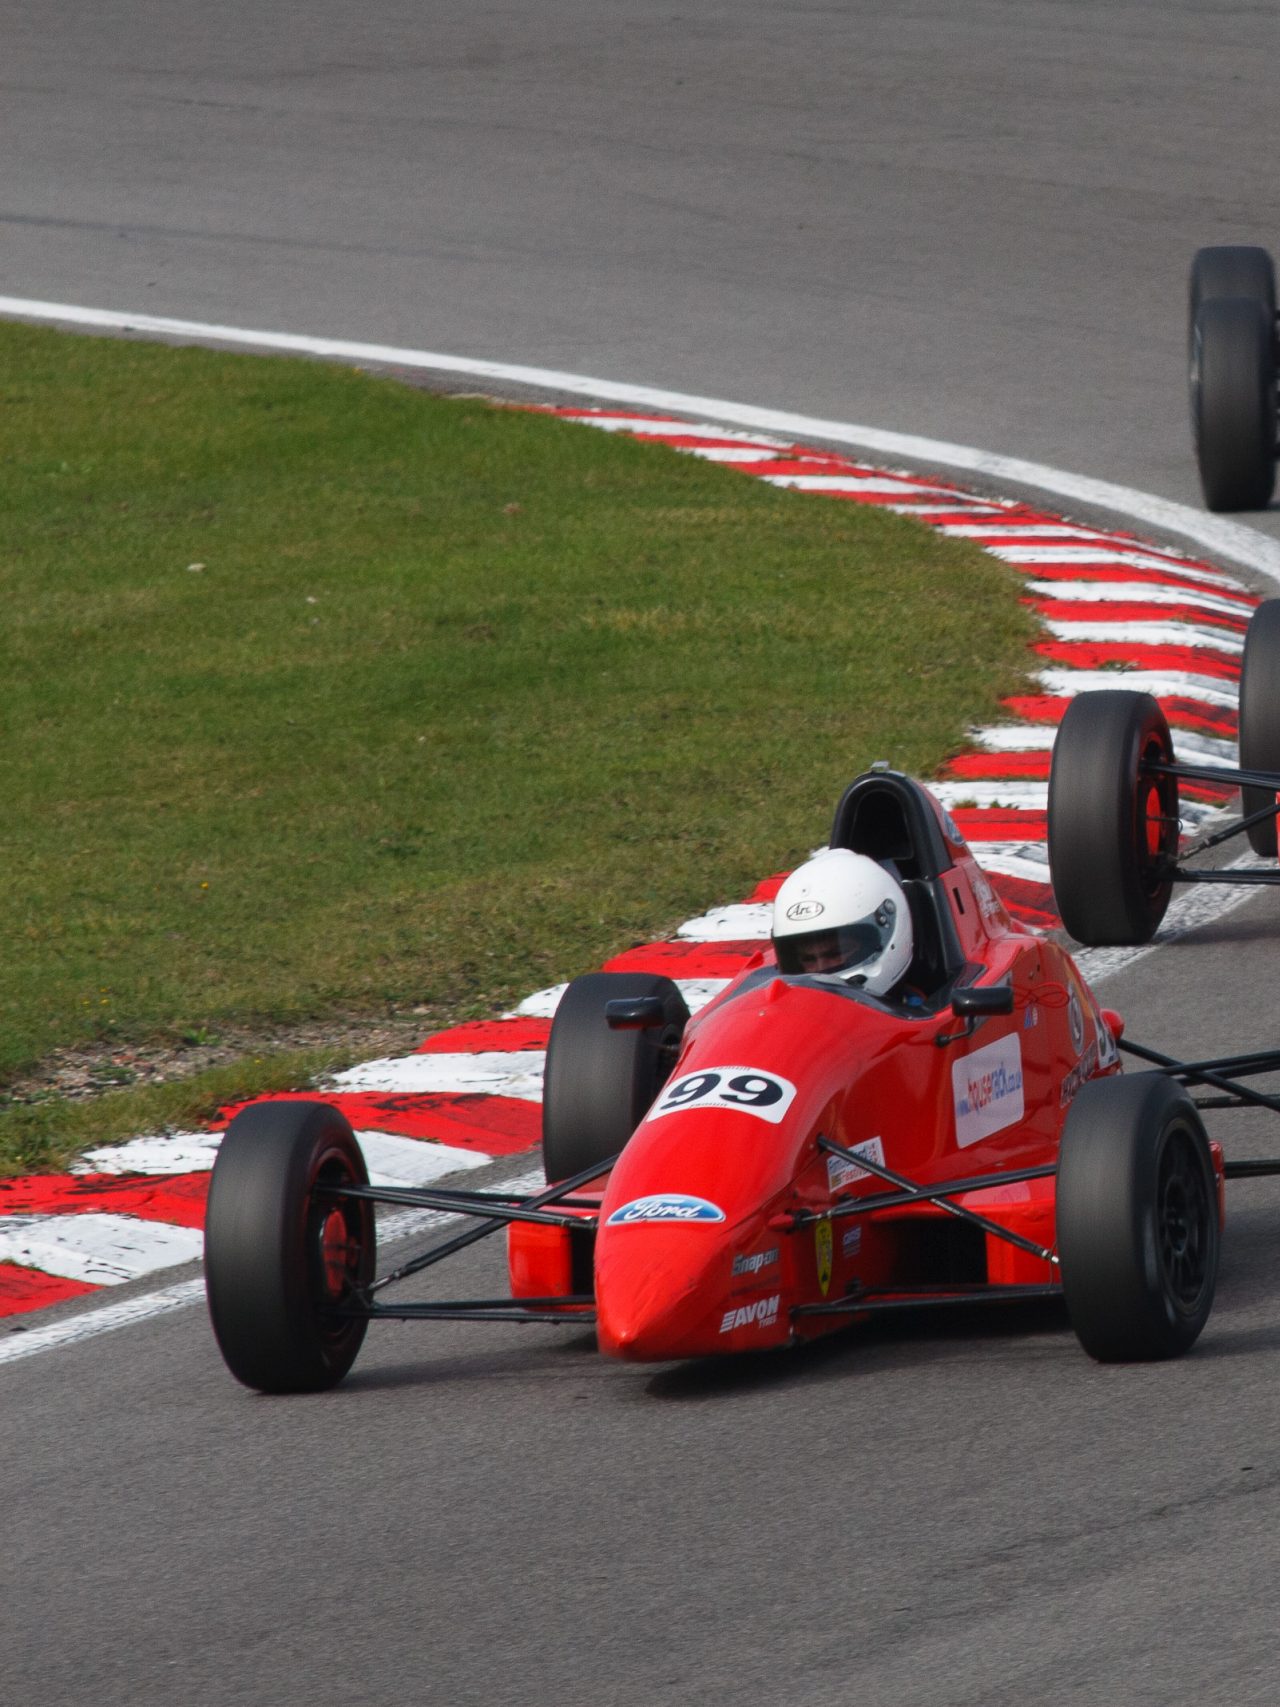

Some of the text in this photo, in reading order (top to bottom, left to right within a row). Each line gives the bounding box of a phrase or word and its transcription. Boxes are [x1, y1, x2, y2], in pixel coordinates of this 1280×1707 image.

[660, 1073, 783, 1110] 99
[624, 1199, 704, 1221] Ford
[732, 1248, 779, 1276] Snap-on
[733, 1295, 780, 1328] AVON
